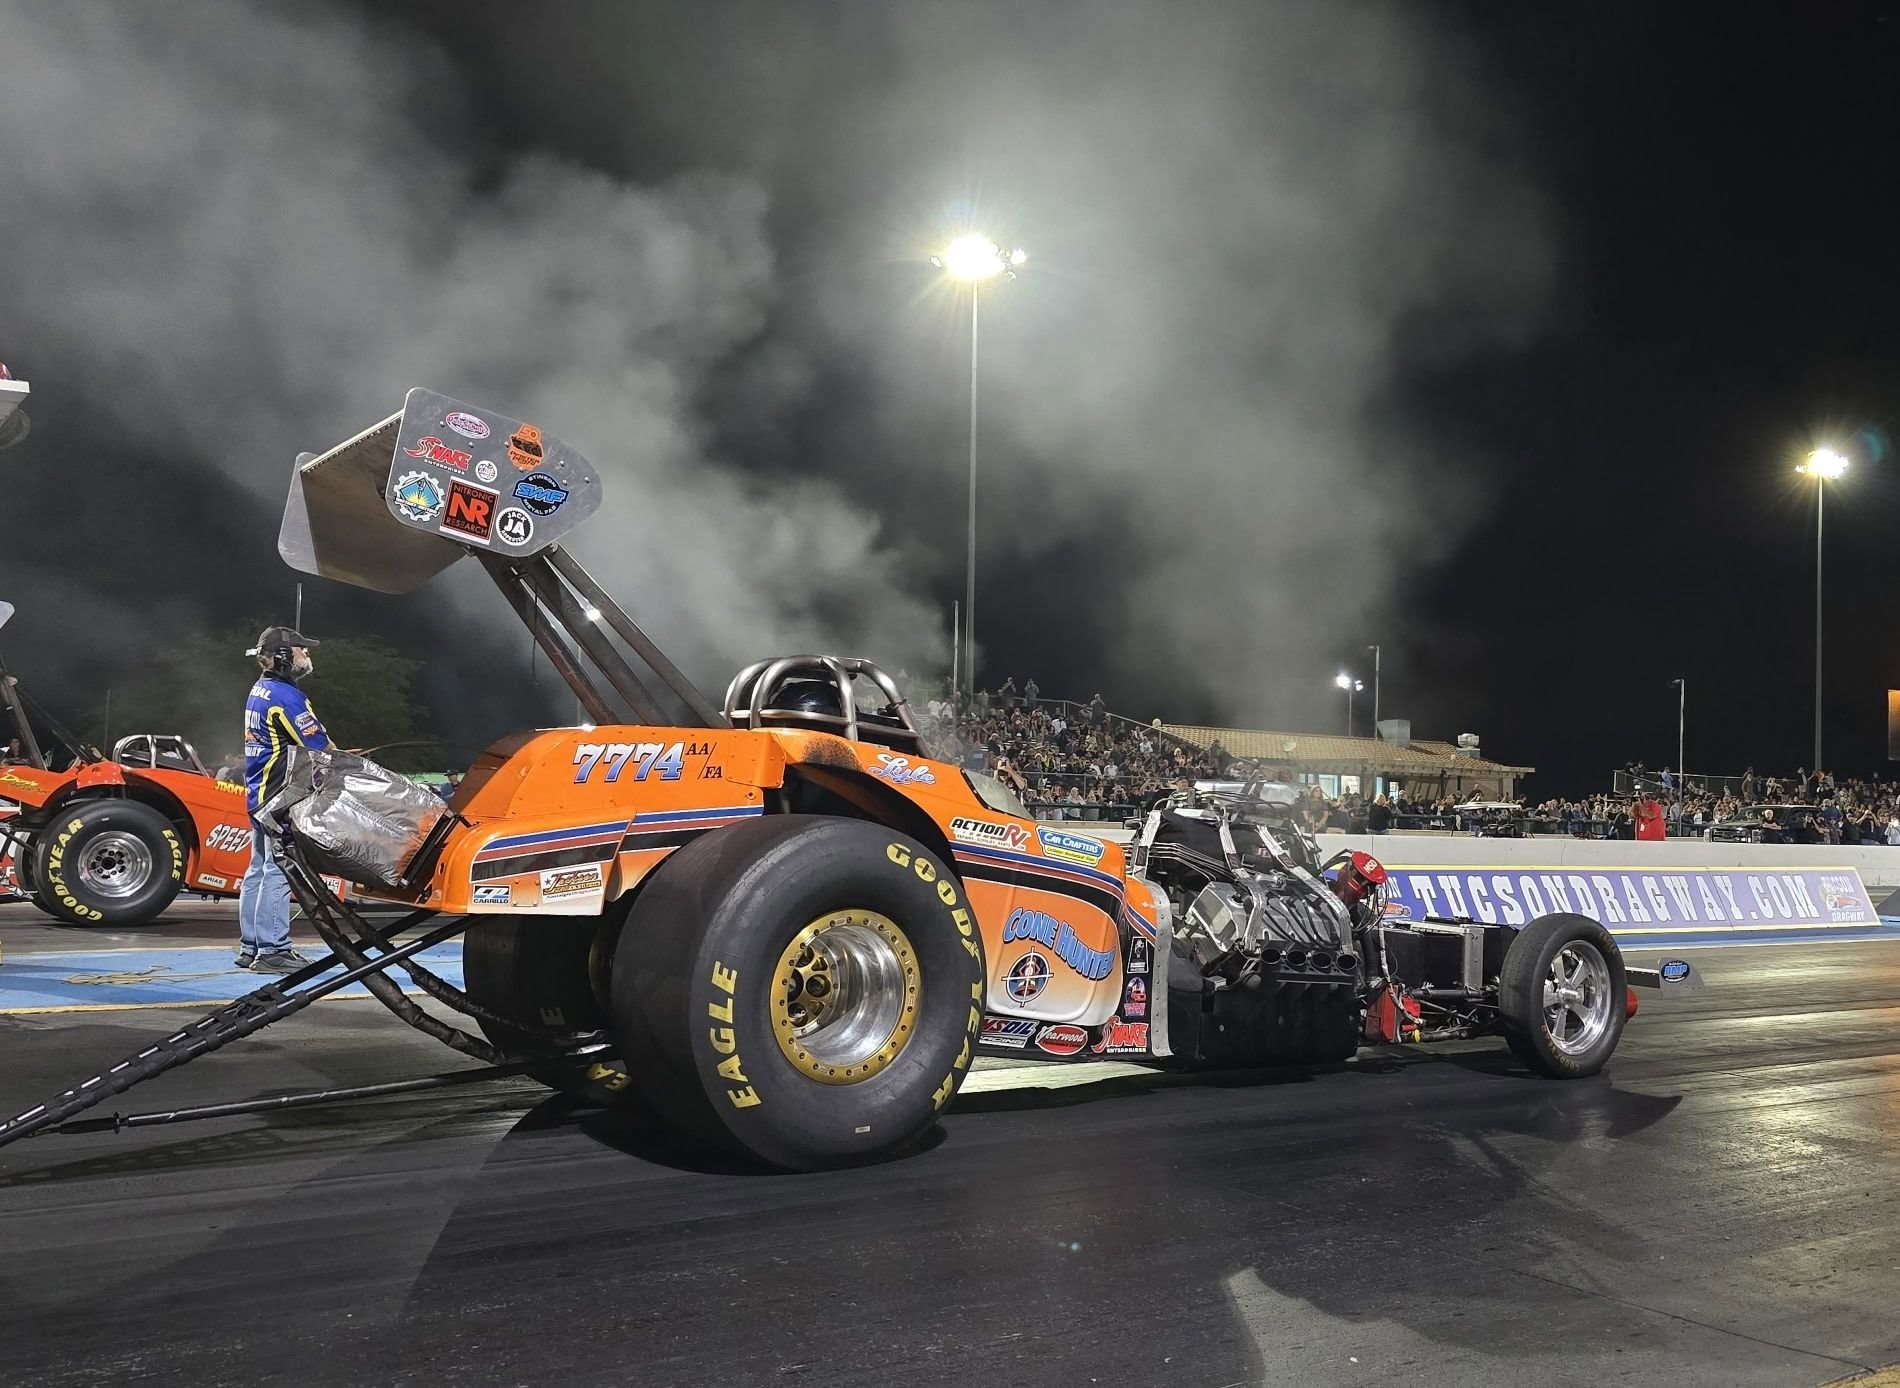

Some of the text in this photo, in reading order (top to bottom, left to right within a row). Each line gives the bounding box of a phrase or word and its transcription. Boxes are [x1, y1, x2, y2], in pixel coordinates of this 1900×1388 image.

[403, 436, 472, 470] SNAKE
[453, 483, 494, 503] NITRONIC
[528, 473, 557, 488] STINSON
[449, 492, 490, 527] NR
[507, 511, 527, 522] JACK
[523, 498, 544, 515] METAL
[445, 516, 488, 536] RESEARCH
[503, 518, 526, 537] JA
[573, 742, 685, 784] 7774
[869, 753, 936, 785] Lyle
[951, 818, 1005, 836] ACTION
[162, 828, 181, 881] EAGLE
[1062, 836, 1099, 853] CRAFTERS
[48, 818, 103, 921] GOODYEAR
[202, 876, 223, 885] ARIAS
[1408, 874, 1821, 926] TUCSONDRAGWAY.COM
[1002, 906, 1059, 951] CONE
[1831, 911, 1865, 922] DRAGWAY
[1054, 919, 1117, 981] HUNTER
[886, 842, 984, 1111] GOODYEAR
[708, 960, 762, 1109] EAGLE
[1035, 1025, 1086, 1044] Yearwood
[1091, 1015, 1149, 1053] SNAKE
